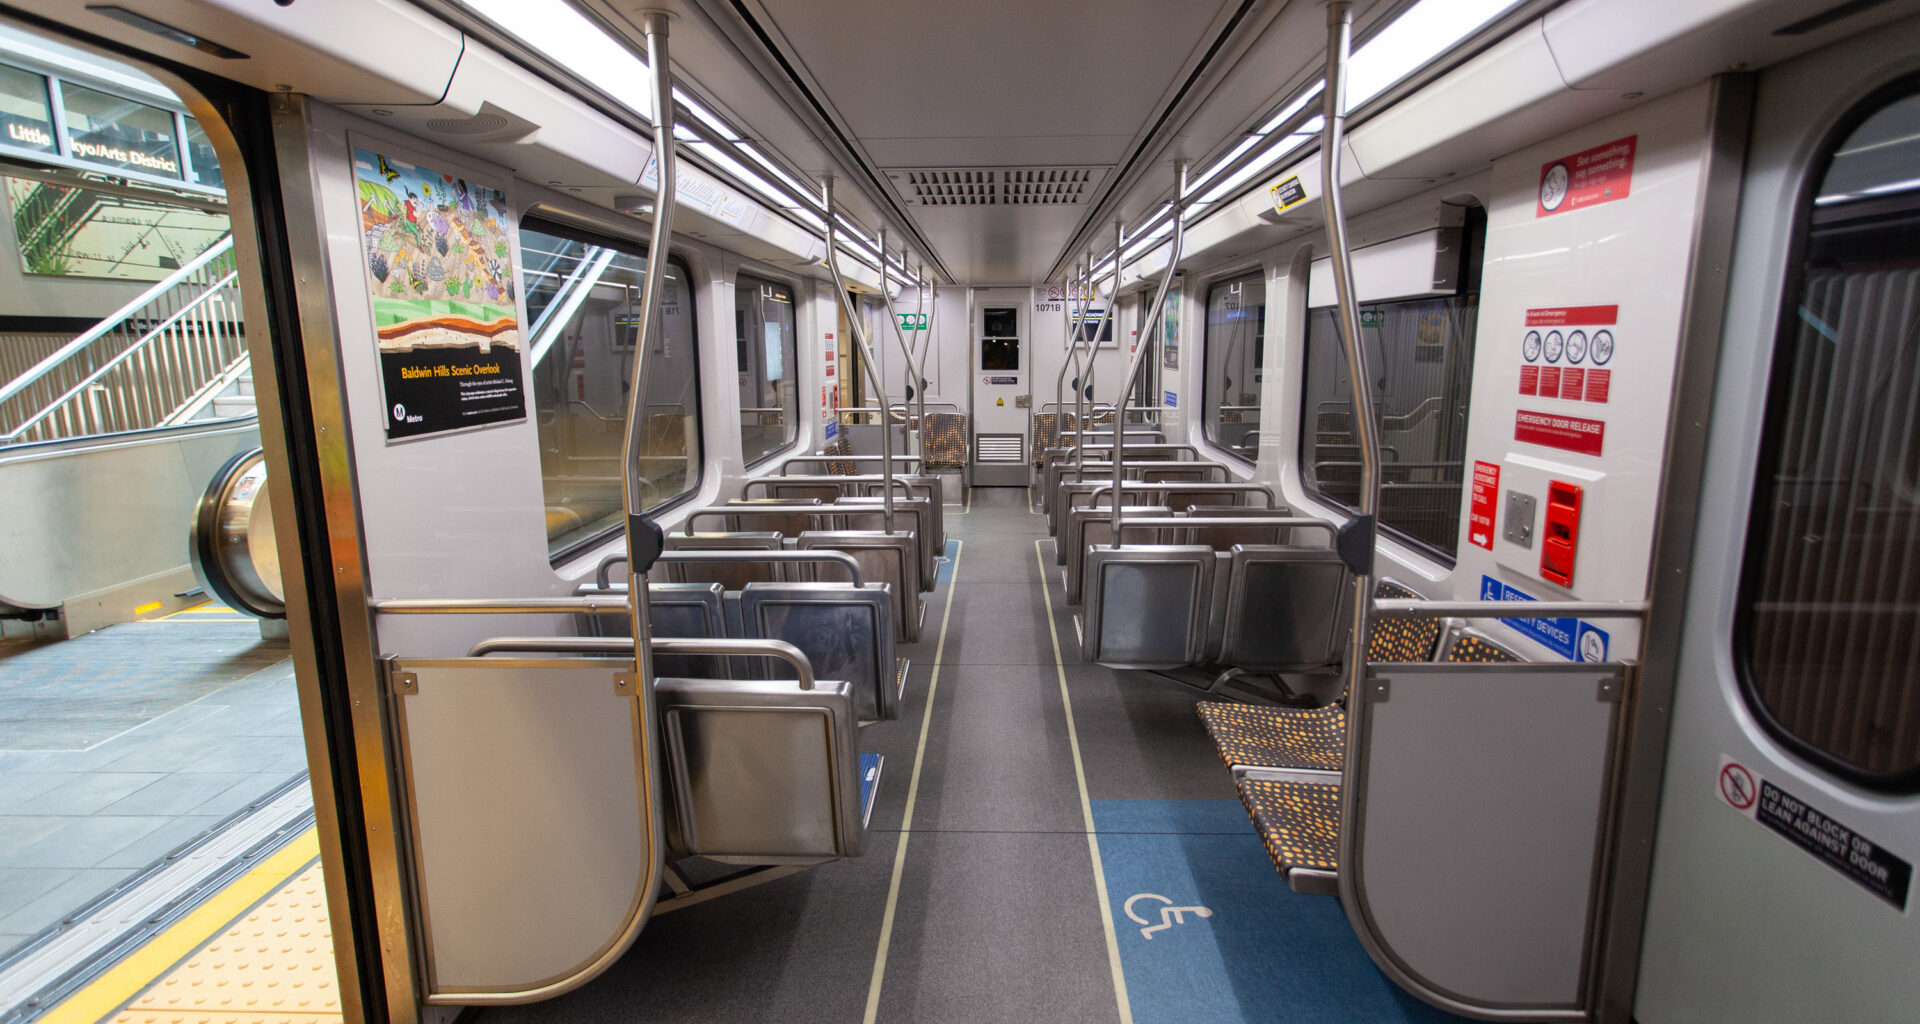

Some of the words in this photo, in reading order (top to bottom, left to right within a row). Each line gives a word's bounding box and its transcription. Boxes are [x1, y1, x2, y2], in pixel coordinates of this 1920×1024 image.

[9, 123, 51, 146] Little
[70, 137, 128, 162] kyo/Arts
[129, 151, 177, 173] District
[1035, 304, 1061, 312] 1071B
[401, 365, 432, 379] Baldwin
[434, 364, 450, 377] Hills
[451, 363, 473, 376] Scenic
[473, 362, 500, 375] Overlook
[406, 414, 423, 423] Metro
[1517, 413, 1552, 427] EMERGENCY
[1551, 418, 1569, 429] DOOR
[1569, 420, 1601, 434] RELEASE
[1475, 463, 1497, 476] EMERGENCY
[1536, 620, 1570, 645] DEVICES
[1763, 784, 1779, 802] DO
[1781, 794, 1806, 816] NOT
[1806, 809, 1850, 843] BLOCK
[1851, 835, 1871, 857] OR
[1761, 798, 1792, 823] LEAN
[1793, 819, 1847, 858] AGAINST
[1849, 852, 1888, 884] DOOR
